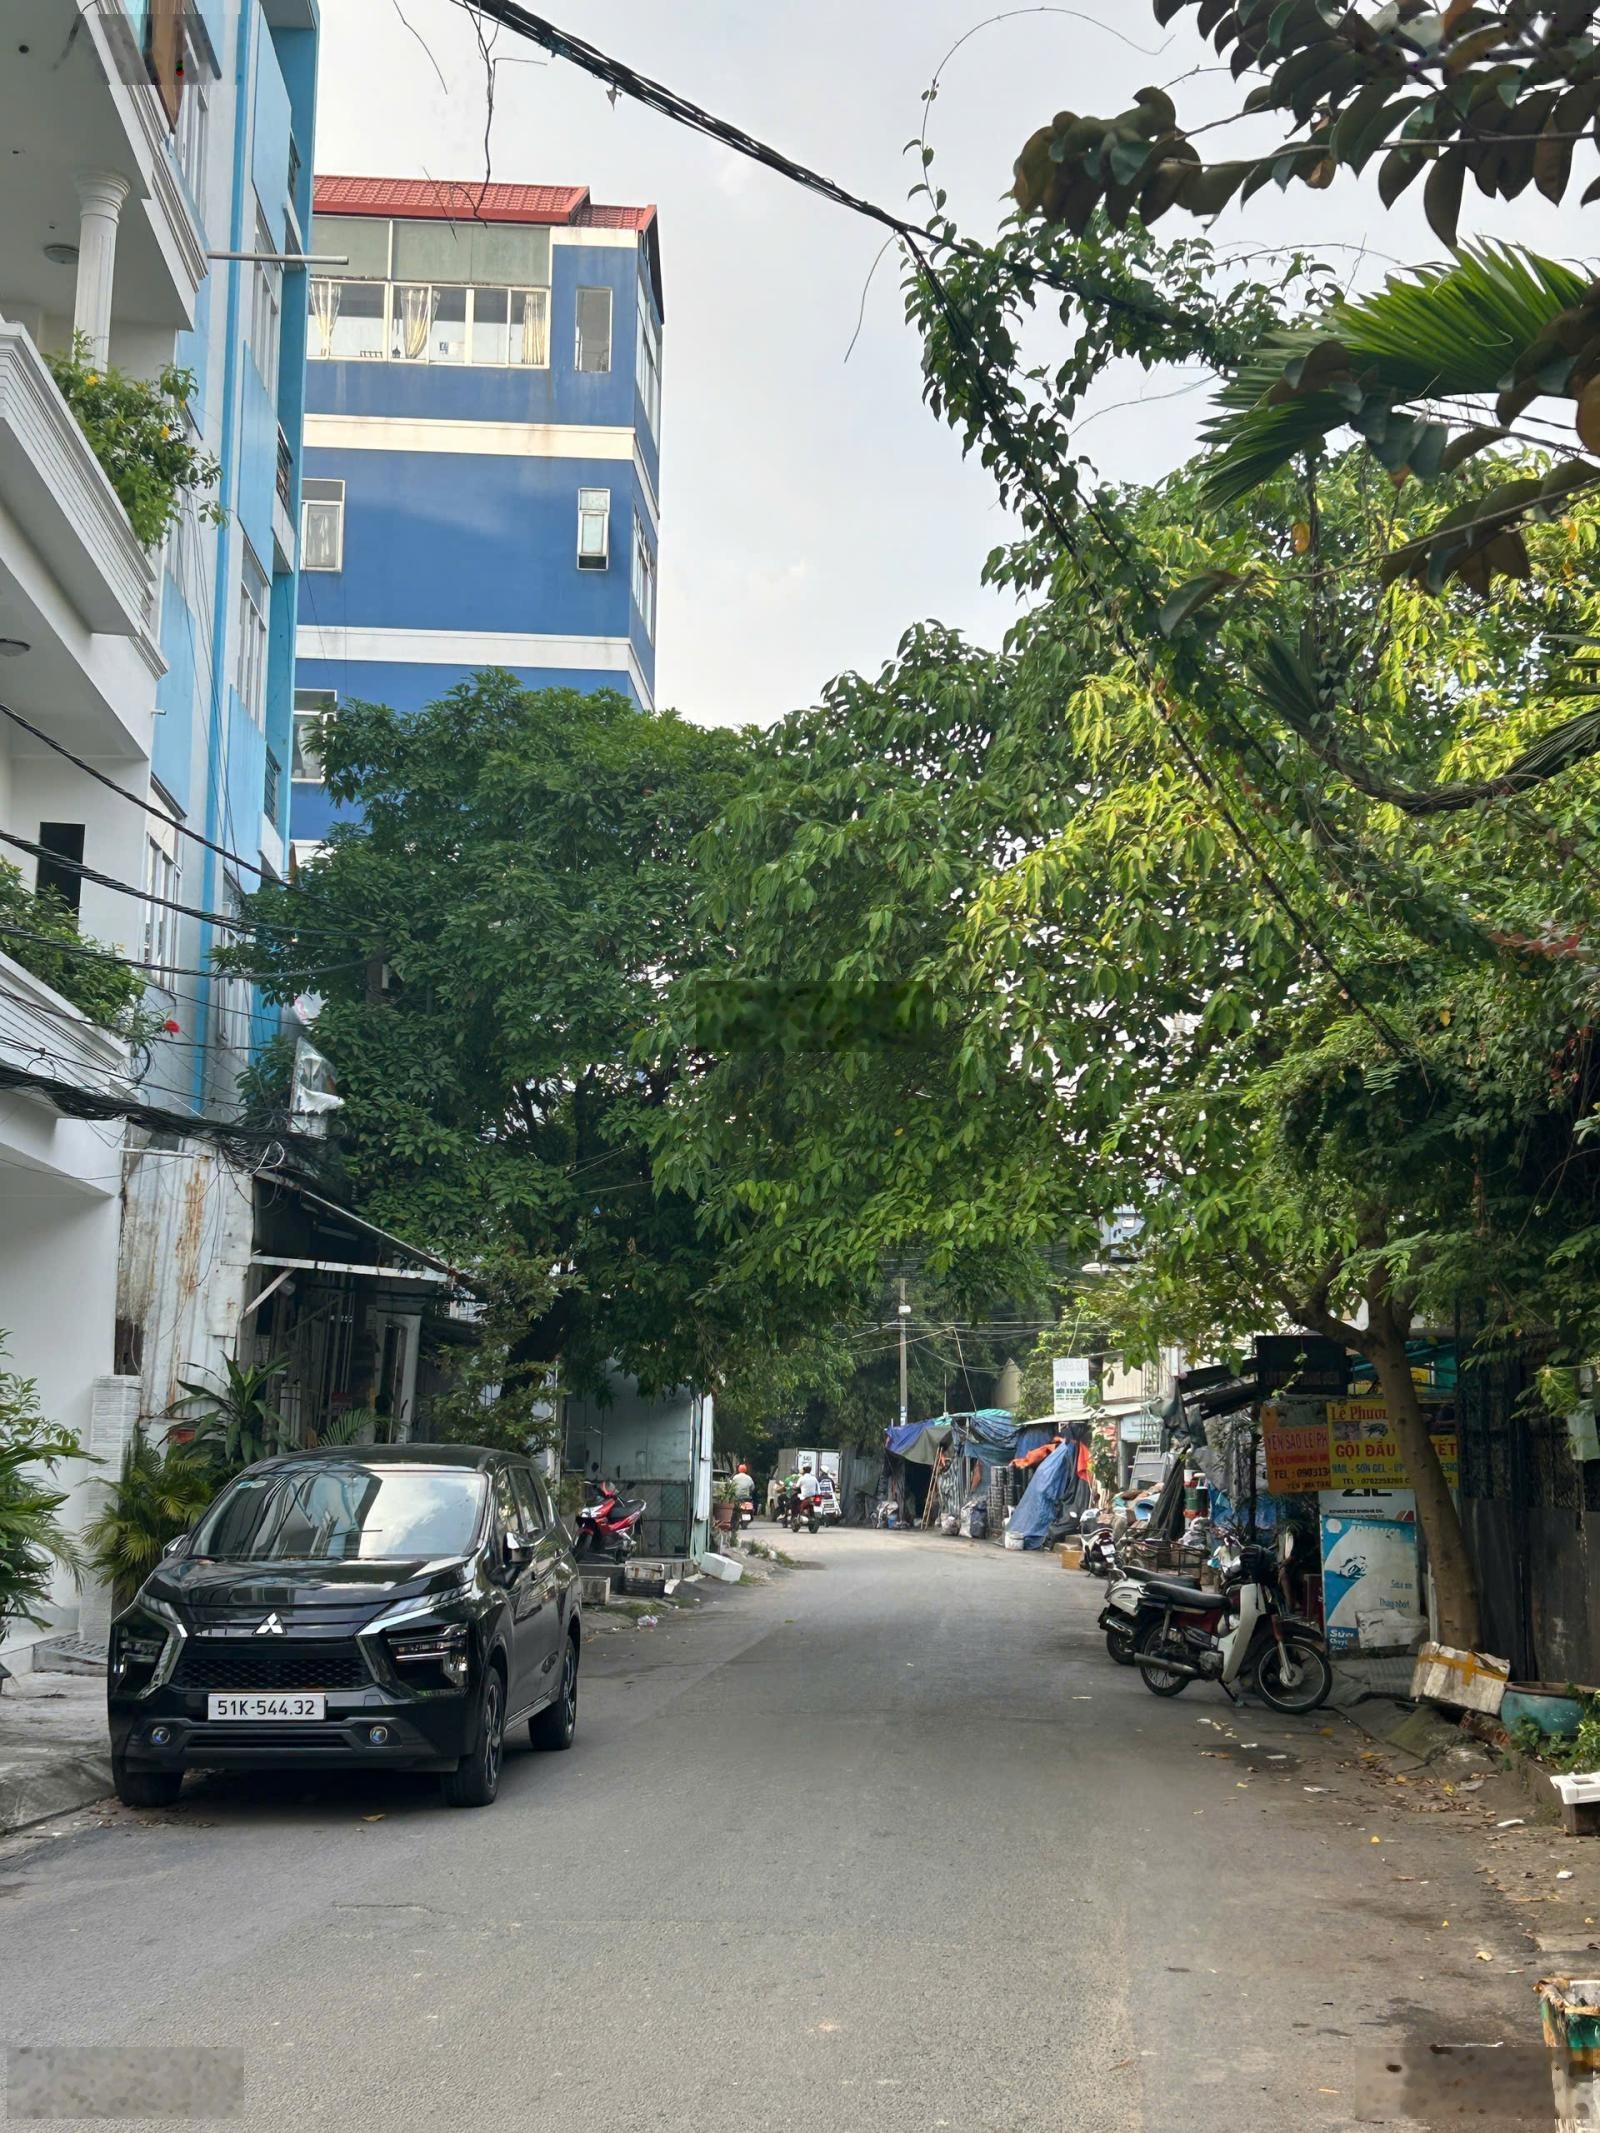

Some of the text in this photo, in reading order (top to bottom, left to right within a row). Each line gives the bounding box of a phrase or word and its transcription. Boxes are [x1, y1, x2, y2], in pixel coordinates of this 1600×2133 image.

[1336, 1441, 1360, 1460] GỘI
[1365, 1440, 1396, 1457] ĐẦU
[218, 1700, 315, 1716] 51K-544.32
